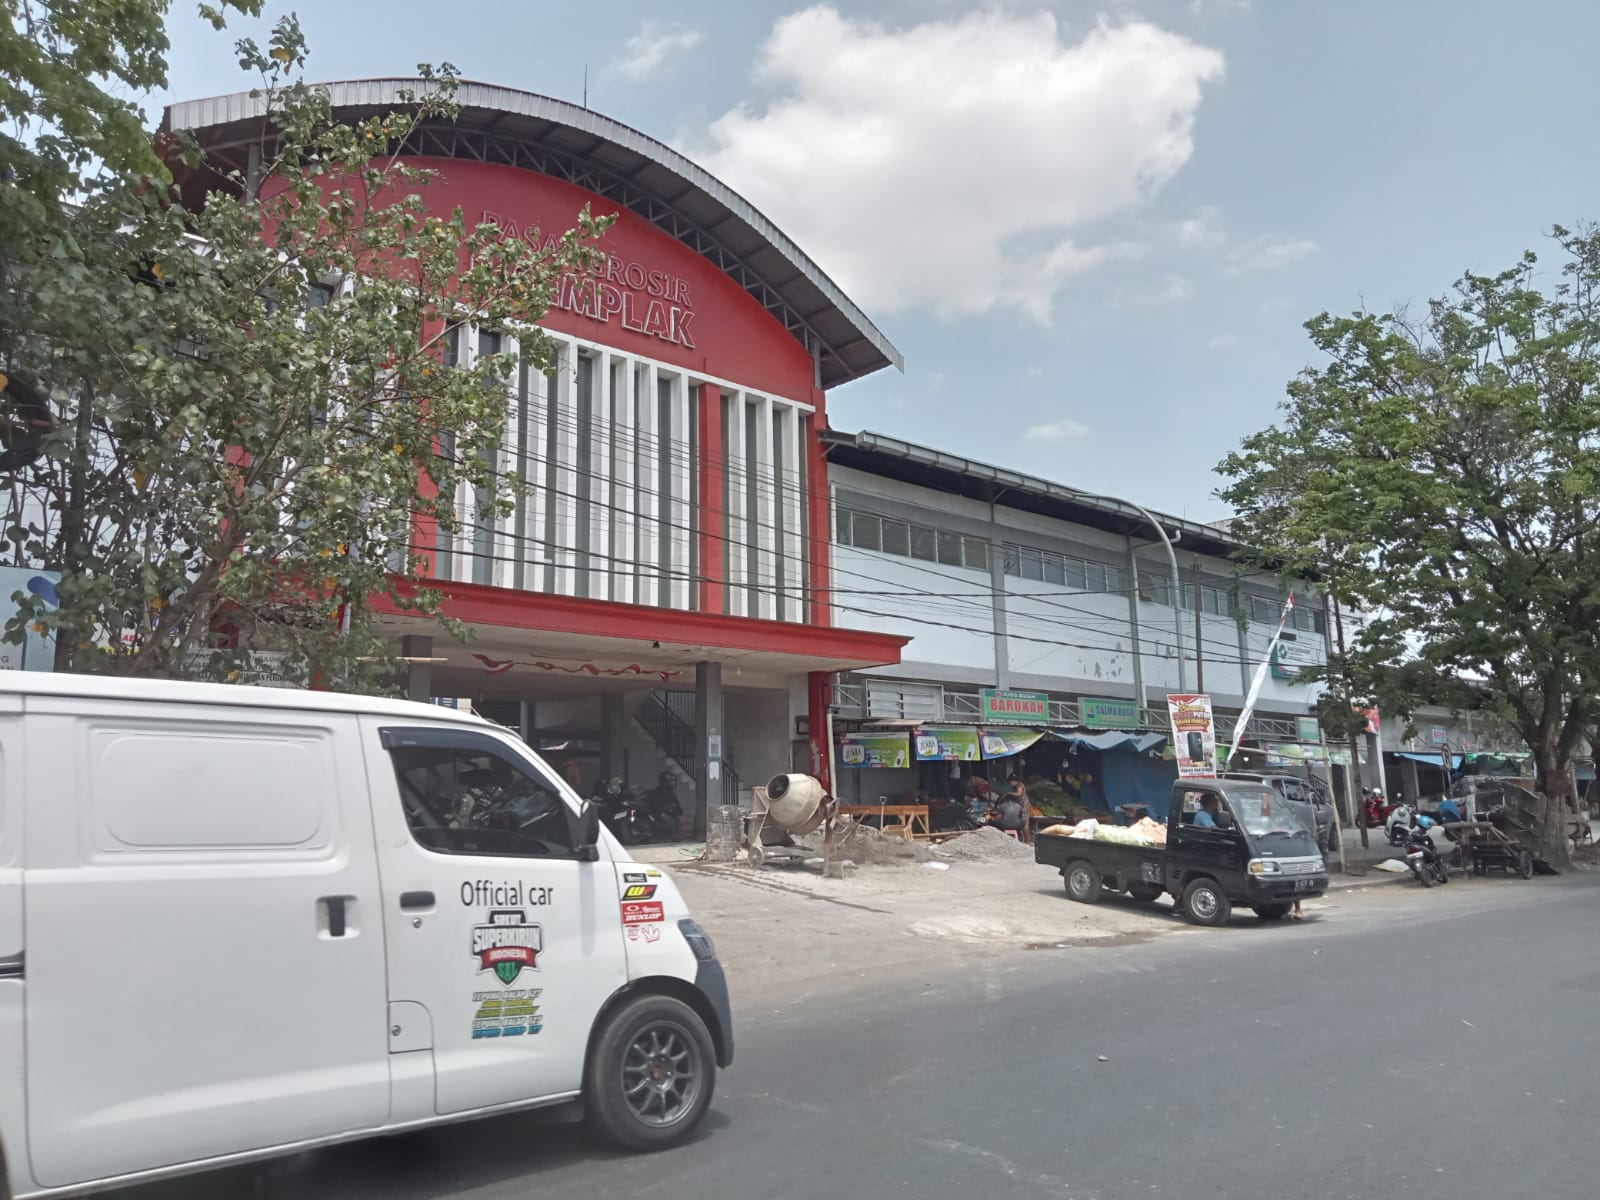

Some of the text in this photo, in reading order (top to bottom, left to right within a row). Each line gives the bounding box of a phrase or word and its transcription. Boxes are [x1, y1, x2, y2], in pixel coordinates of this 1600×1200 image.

[990, 698, 1044, 714] BAROKAH
[461, 880, 554, 906] Official car
